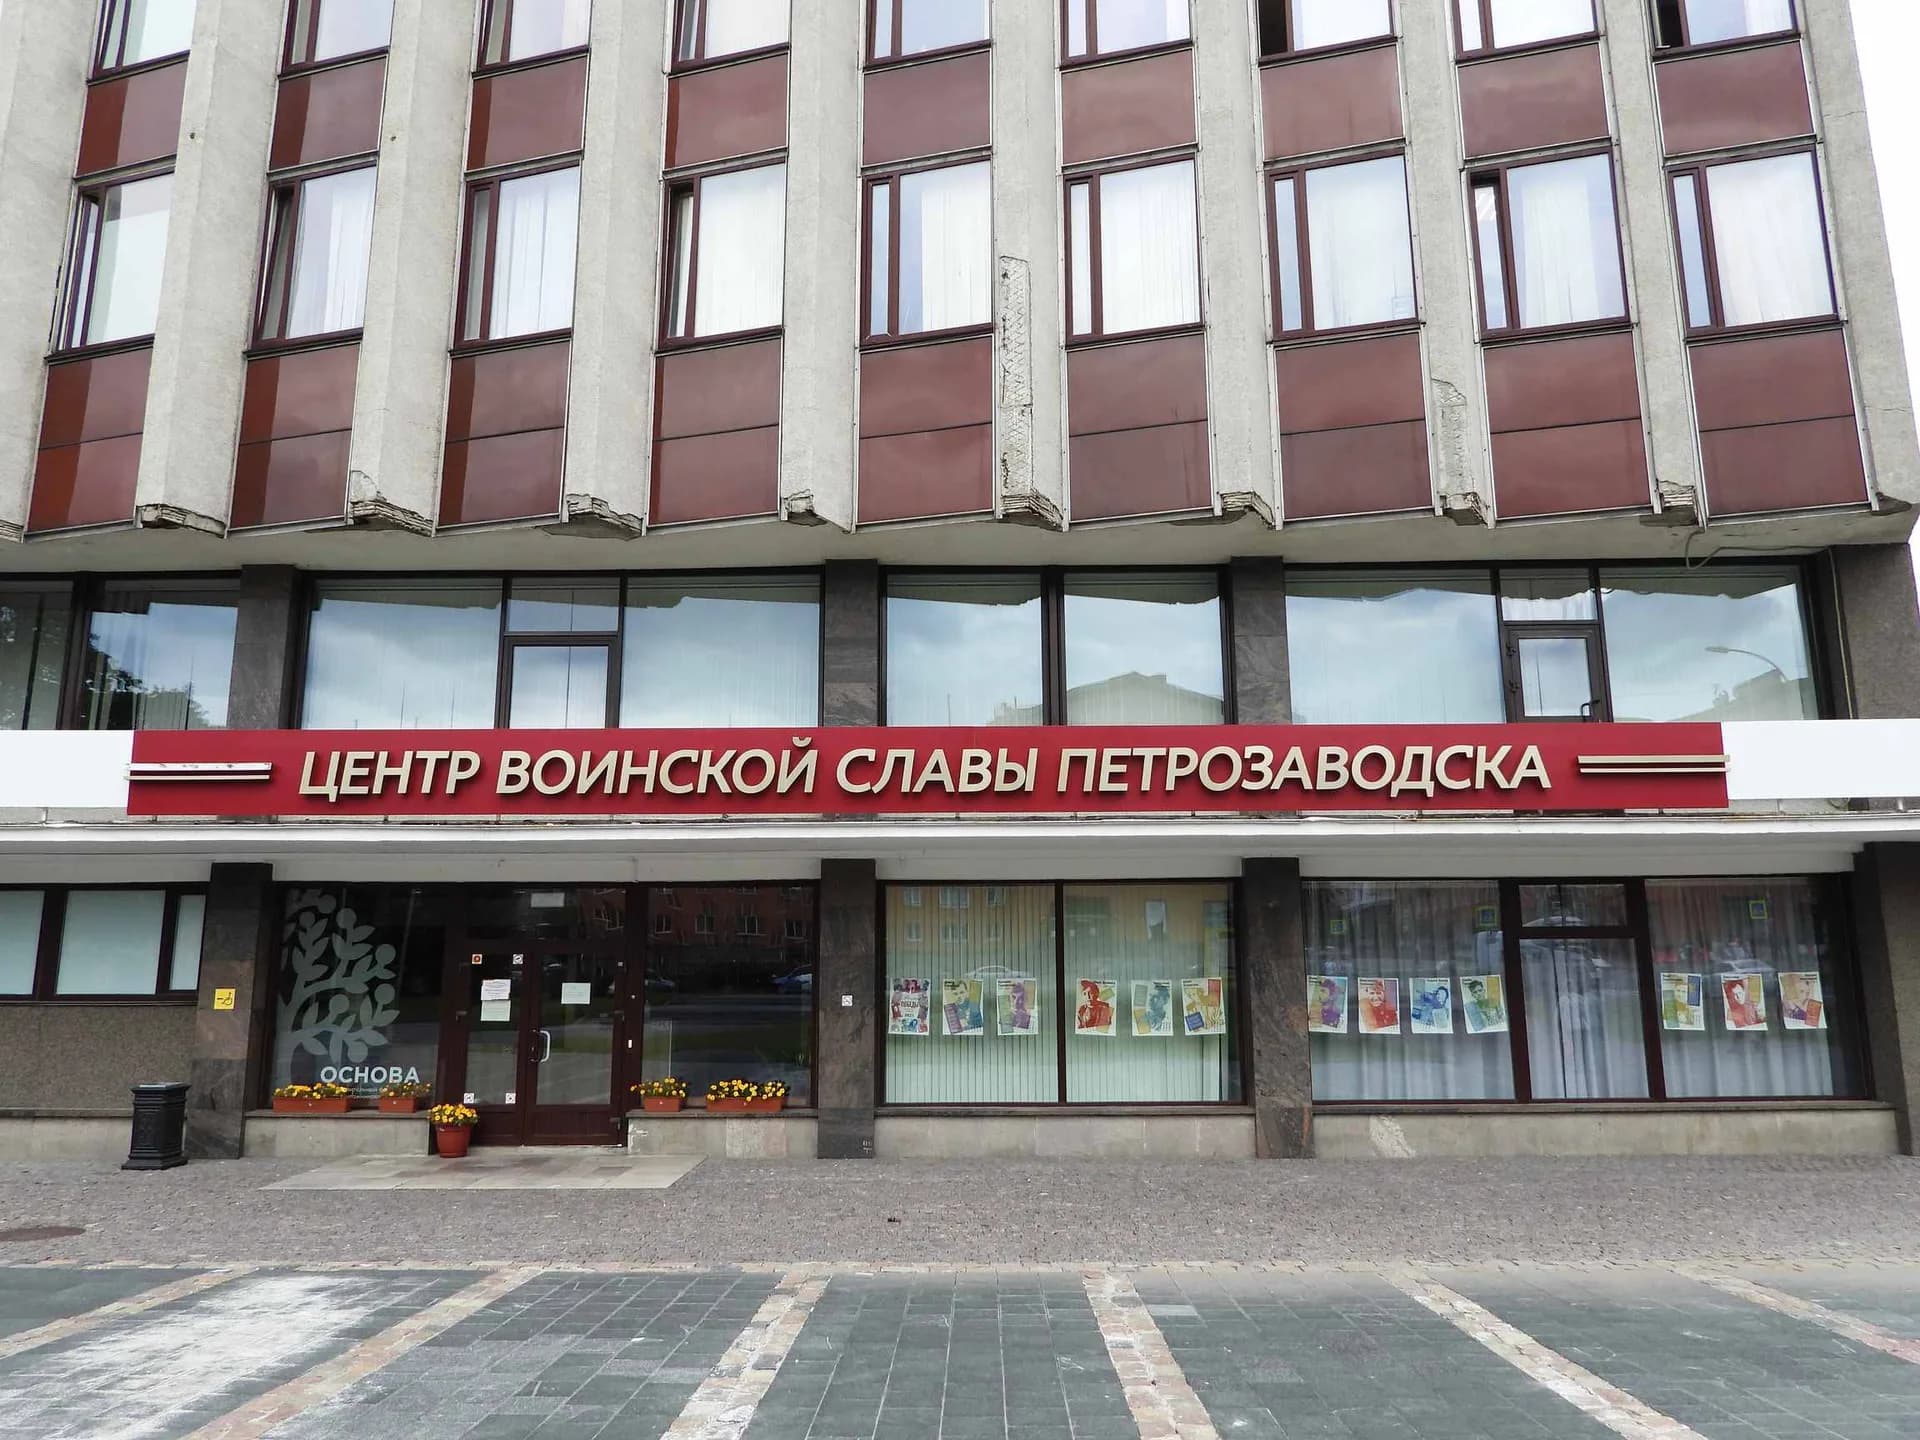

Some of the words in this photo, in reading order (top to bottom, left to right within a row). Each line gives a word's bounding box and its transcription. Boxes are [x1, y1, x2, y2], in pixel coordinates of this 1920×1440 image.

[298, 749, 481, 802] ЦЕНТР
[495, 737, 817, 795] ВОИНСКОЙ
[836, 748, 1039, 794] СЛАВЫ
[1057, 745, 1552, 799] ПЕТРОЗАВОДСКА
[320, 1066, 420, 1083] ОСНОВА
